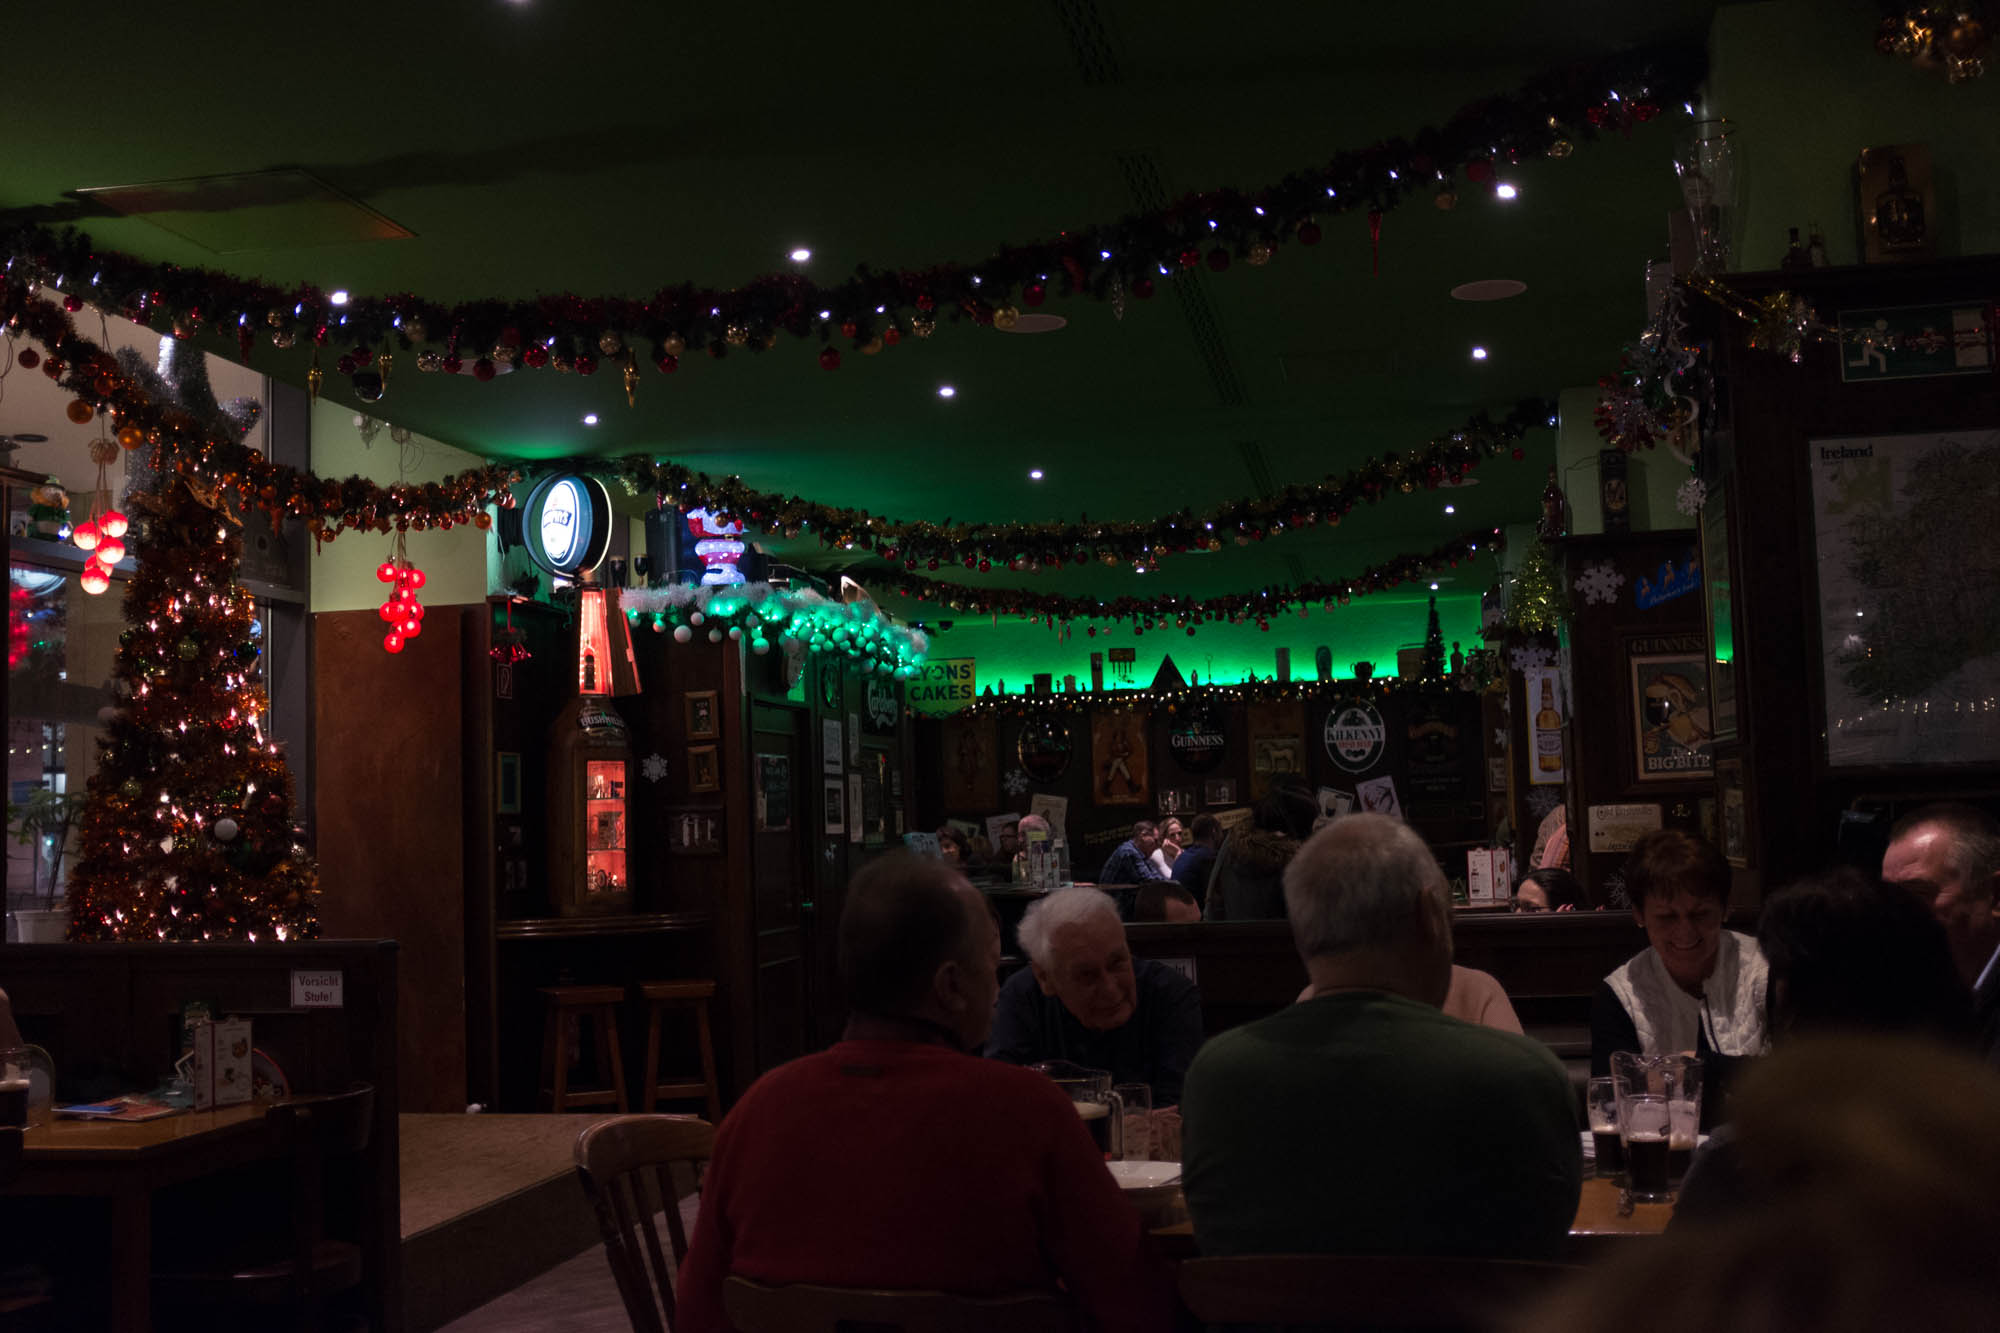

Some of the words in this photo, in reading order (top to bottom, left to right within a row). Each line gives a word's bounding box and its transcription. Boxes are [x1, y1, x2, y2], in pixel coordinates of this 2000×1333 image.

[1821, 445, 1873, 459] Ireland
[910, 663, 970, 681] YONS
[910, 684, 971, 701] CAKES
[1171, 733, 1224, 748] GUINNESS
[1327, 727, 1382, 741] KILKENNY
[1647, 756, 1675, 770] BIG
[1677, 754, 1711, 769] BITE
[299, 975, 339, 986] Vorsicht
